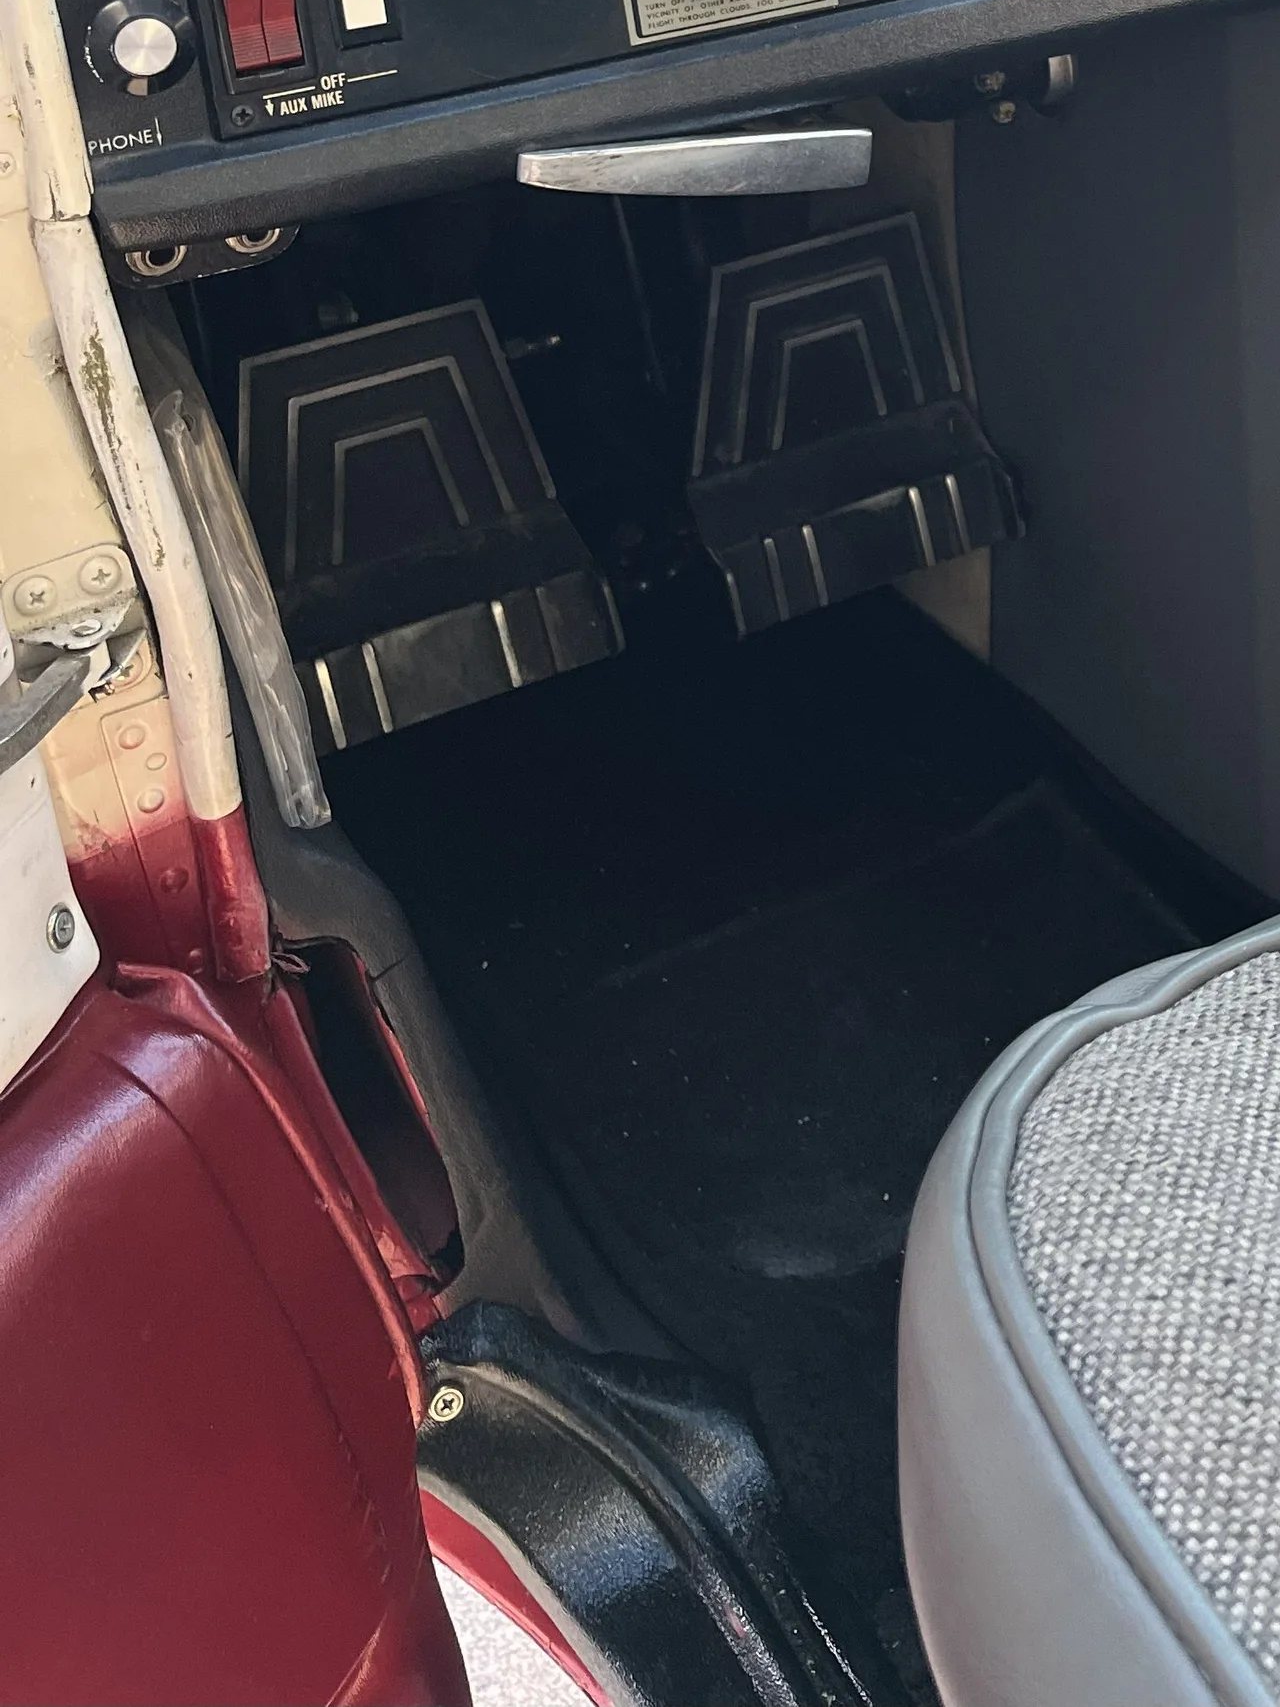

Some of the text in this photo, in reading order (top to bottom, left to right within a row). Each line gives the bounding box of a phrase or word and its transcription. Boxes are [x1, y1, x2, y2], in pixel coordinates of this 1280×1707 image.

[645, 2, 666, 11] TURN
[679, 11, 716, 22] THROUGH
[320, 74, 346, 91] OFF
[280, 91, 345, 116] AUX MIKE
[88, 129, 154, 156] PHONE
